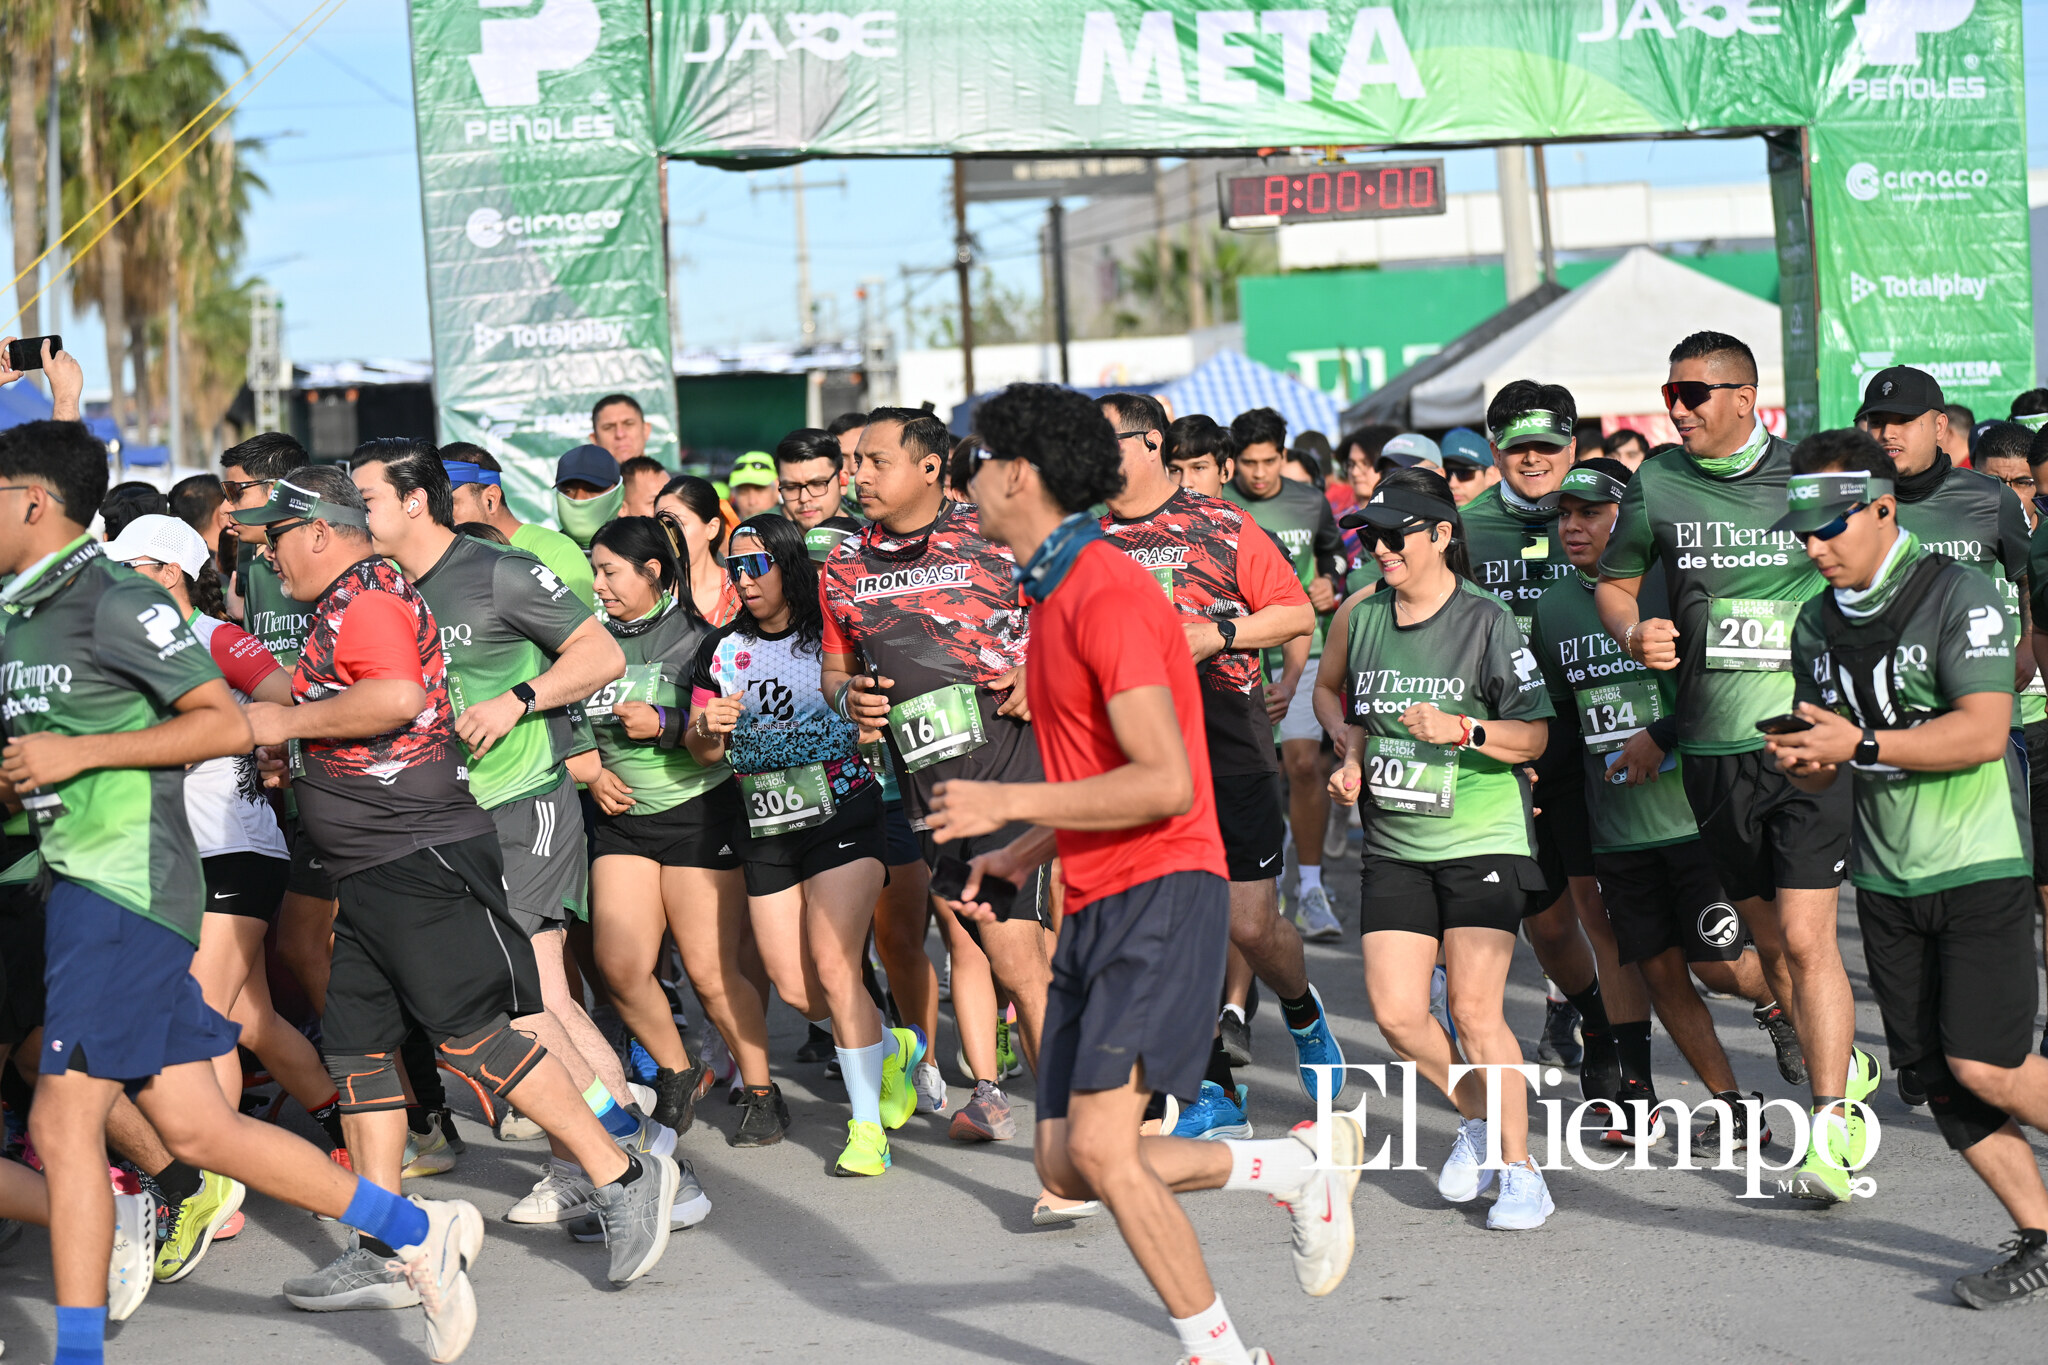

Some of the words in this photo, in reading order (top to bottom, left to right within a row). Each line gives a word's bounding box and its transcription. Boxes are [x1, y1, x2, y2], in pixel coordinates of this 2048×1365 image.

[1075, 7, 1426, 105] META
[1880, 272, 1987, 301] Totalplay
[510, 319, 625, 349] Totalplay
[1673, 522, 1703, 548] El
[1483, 560, 1510, 584] El
[1677, 553, 1707, 569] de
[1710, 551, 1789, 569] todos
[856, 564, 972, 596] IRONCAST
[1719, 618, 1787, 648] 204
[1558, 638, 1580, 666] El
[1355, 671, 1376, 696] El
[1377, 670, 1465, 700] Tiempo
[1566, 668, 1586, 683] de
[966, 698, 982, 743] MEDALLA
[1354, 700, 1371, 716] de
[1586, 702, 1638, 733] 134
[901, 709, 952, 749] 161
[1379, 738, 1416, 748] CARRERA
[1370, 755, 1428, 790] 207
[1441, 761, 1454, 808] MEDALLA
[751, 786, 804, 818] 306
[815, 774, 833, 815] MEDALLA
